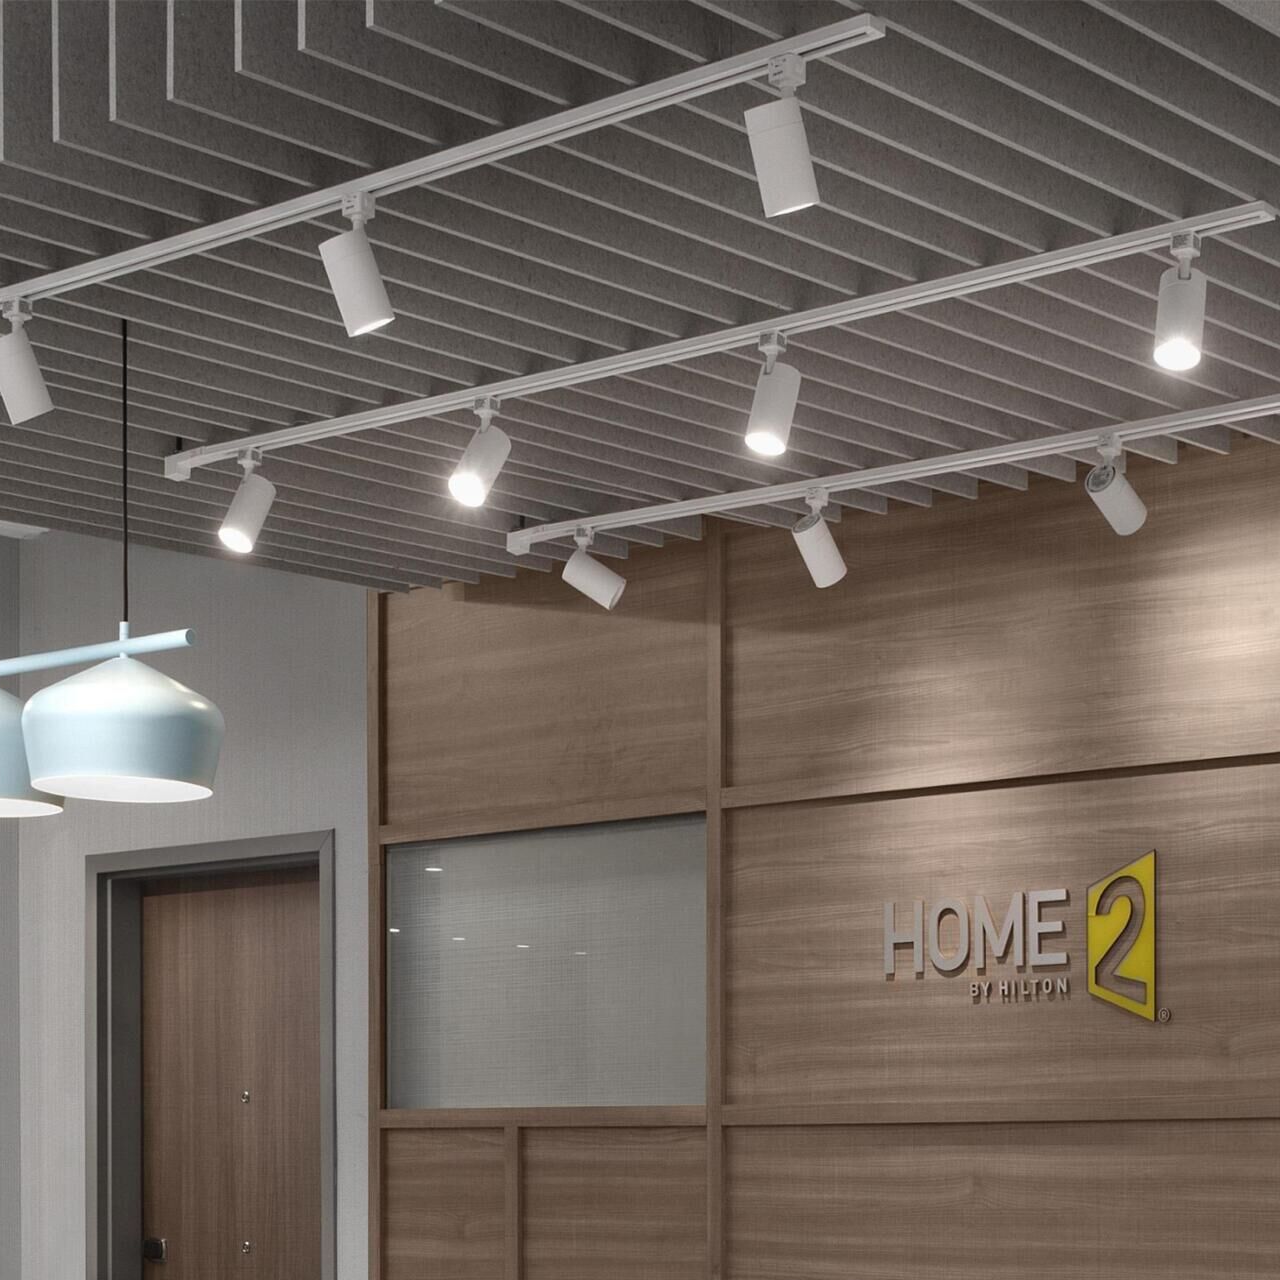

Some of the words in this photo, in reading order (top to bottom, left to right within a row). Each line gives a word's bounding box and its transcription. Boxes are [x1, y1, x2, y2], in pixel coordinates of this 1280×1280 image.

[884, 888, 1068, 977] HOME
[1095, 875, 1147, 1006] 2
[970, 981, 991, 998] BY
[998, 977, 1068, 998] HILTON
